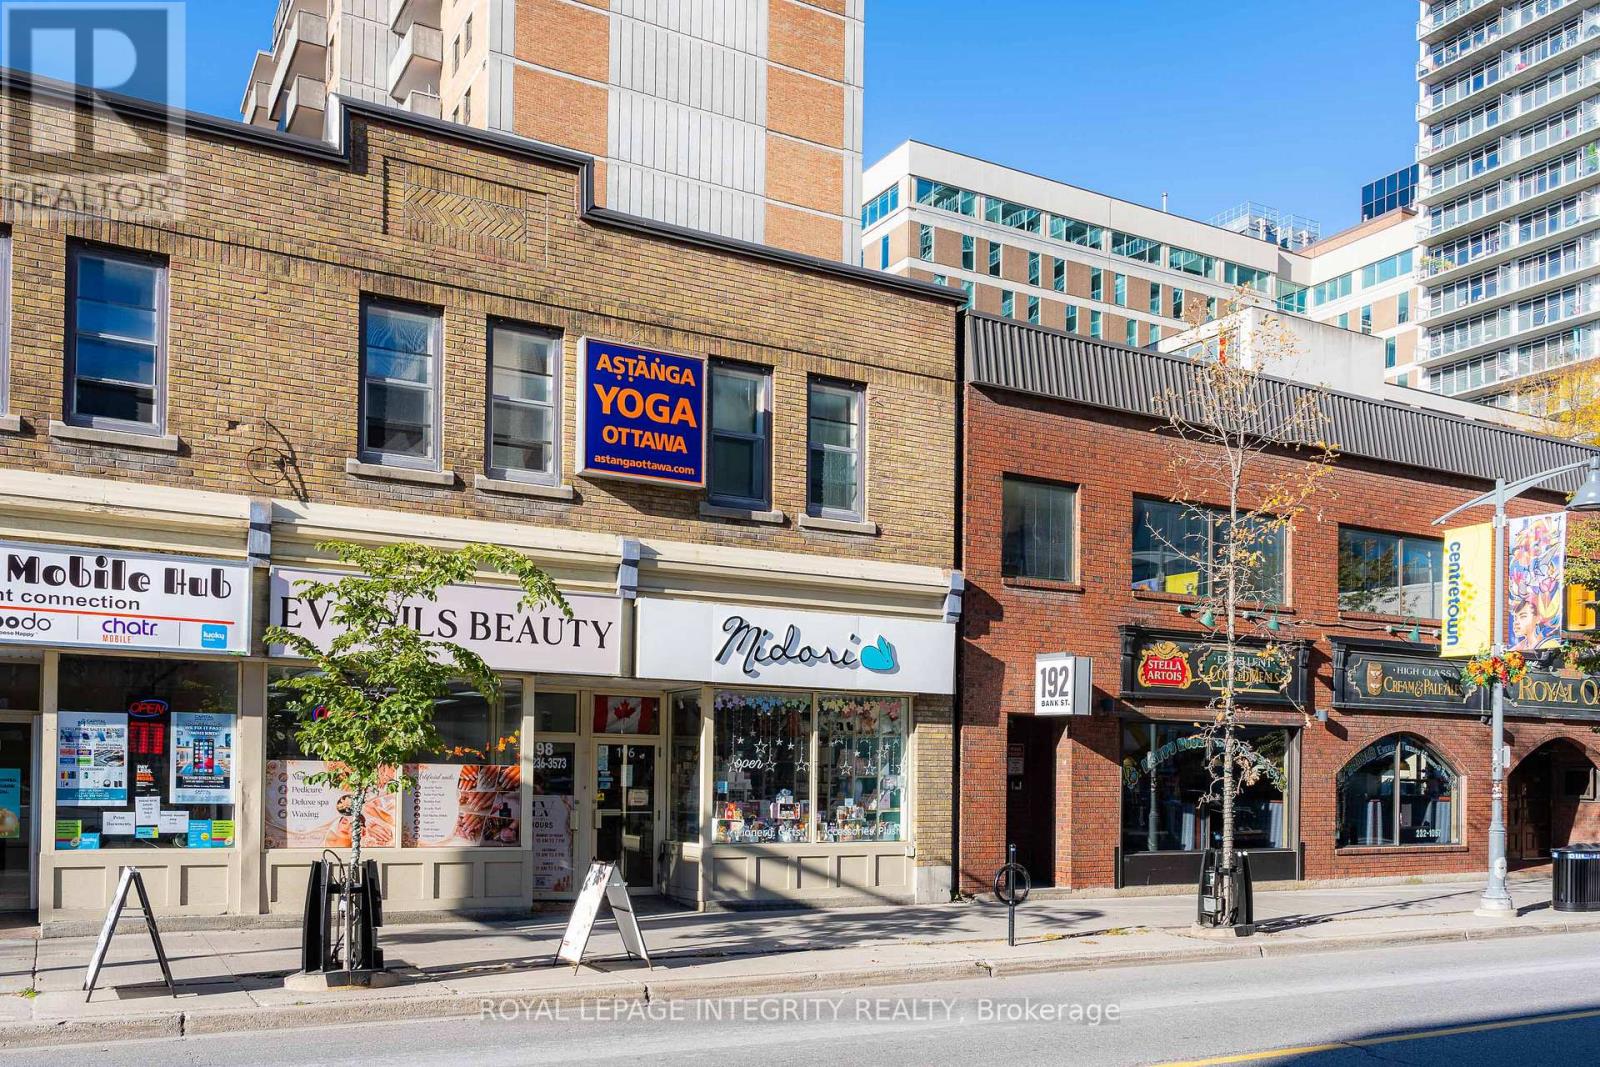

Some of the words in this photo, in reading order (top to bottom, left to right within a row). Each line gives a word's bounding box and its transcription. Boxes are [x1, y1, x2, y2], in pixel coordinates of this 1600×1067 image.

[593, 383, 697, 428] YOGA
[602, 425, 688, 454] OTTAWA
[594, 454, 695, 475] astangaottawa.com
[7, 554, 151, 592] Mobile
[164, 567, 232, 599] Hub
[21, 592, 140, 610] connection
[1447, 541, 1461, 646] centretown
[0, 612, 51, 631] odo
[103, 617, 158, 637] chatr
[344, 600, 458, 638] AILS
[470, 611, 613, 649] BEAUTY
[103, 634, 131, 643] MOBILE
[715, 615, 858, 675] Midori
[1147, 659, 1182, 672] STELLA
[1397, 667, 1419, 675] HIGH
[1422, 668, 1452, 677] CLASS
[1040, 665, 1069, 698] 192
[1147, 670, 1182, 682] ARTOIS
[1383, 676, 1415, 694] CREAM
[1518, 675, 1579, 703] ROYAL
[1580, 679, 1600, 706] O
[130, 702, 165, 715] OPEN
[1041, 699, 1059, 707] BANK
[616, 747, 636, 758] 16
[317, 800, 329, 808] spa
